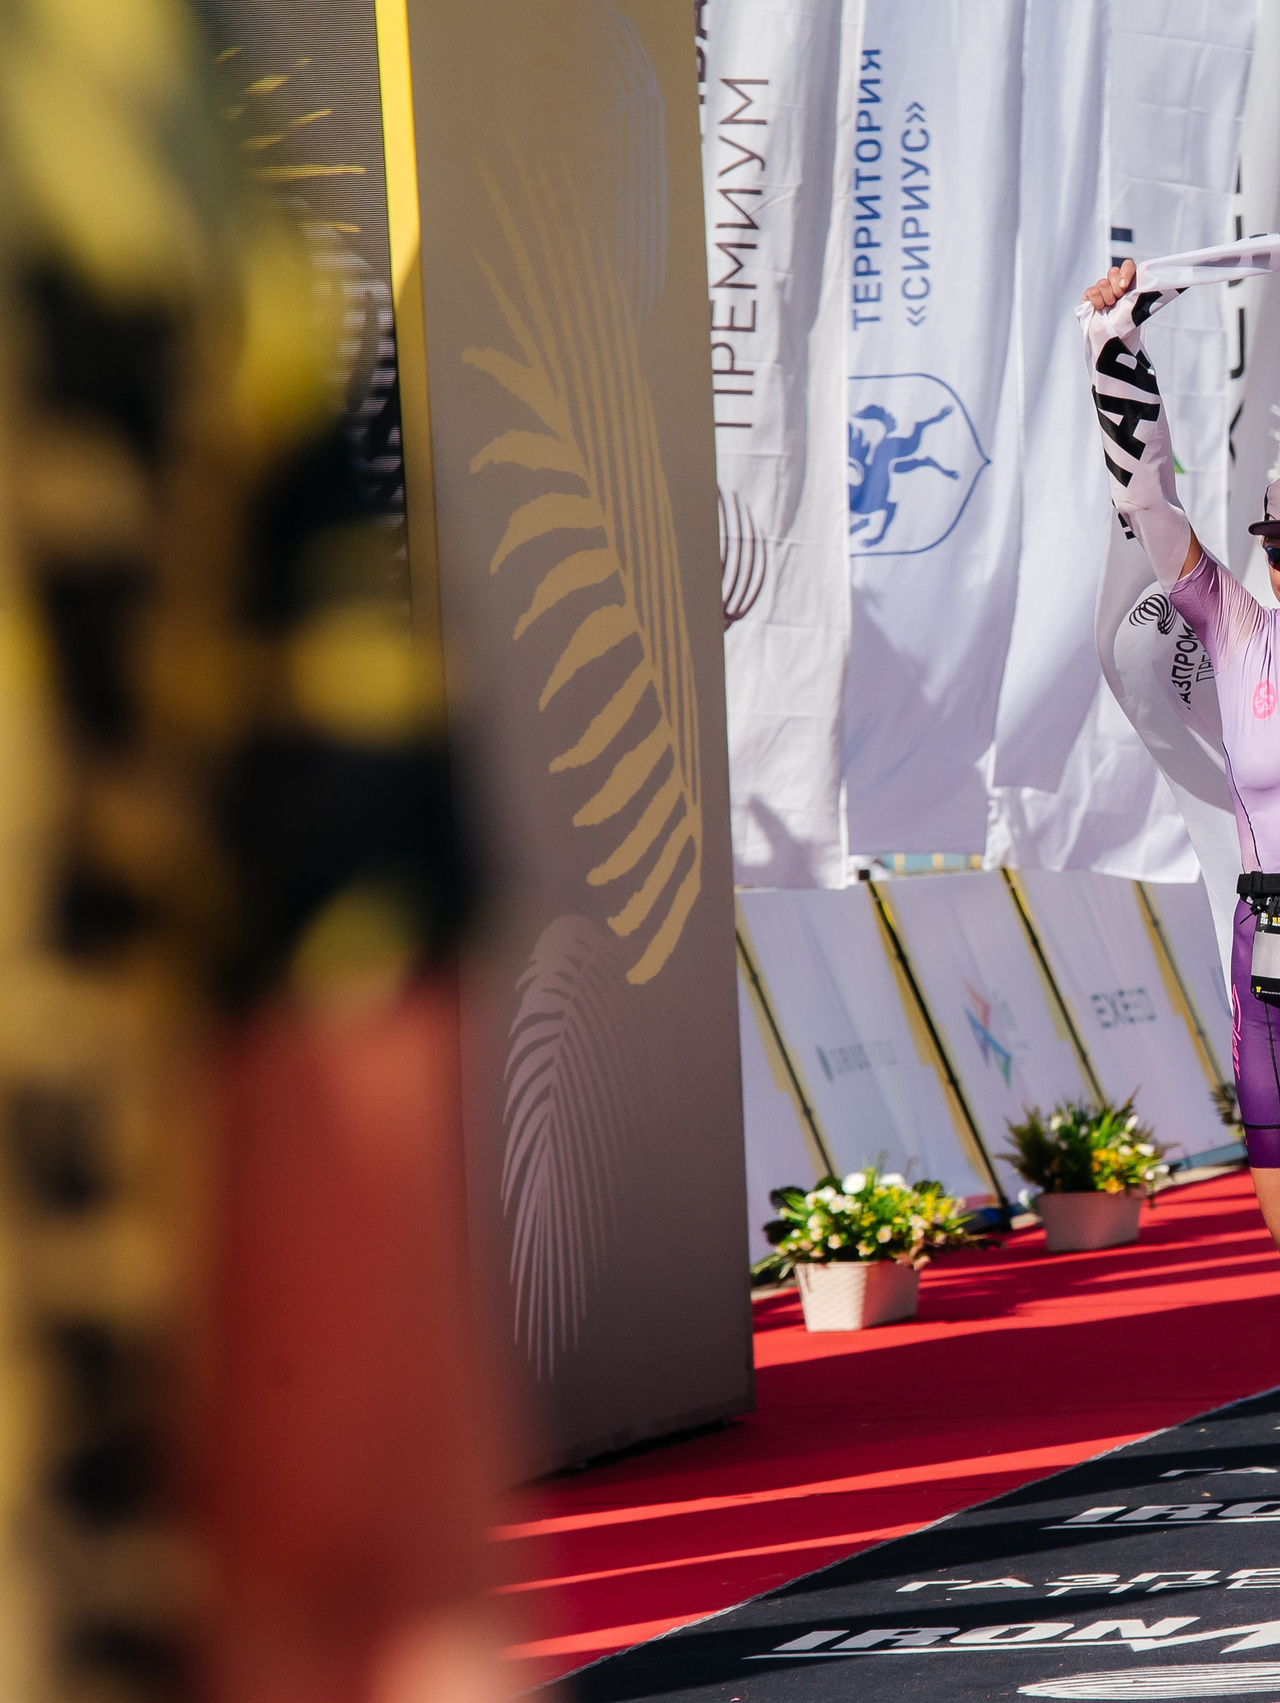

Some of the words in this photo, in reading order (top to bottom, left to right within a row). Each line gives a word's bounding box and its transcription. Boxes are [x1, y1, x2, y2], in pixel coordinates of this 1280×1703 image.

[711, 77, 769, 430] ПРЕМИУМ
[852, 48, 883, 331] ТЕРРИТОРИЯ
[900, 101, 931, 327] «СИРИУС»
[773, 1616, 1201, 1651] IRON
